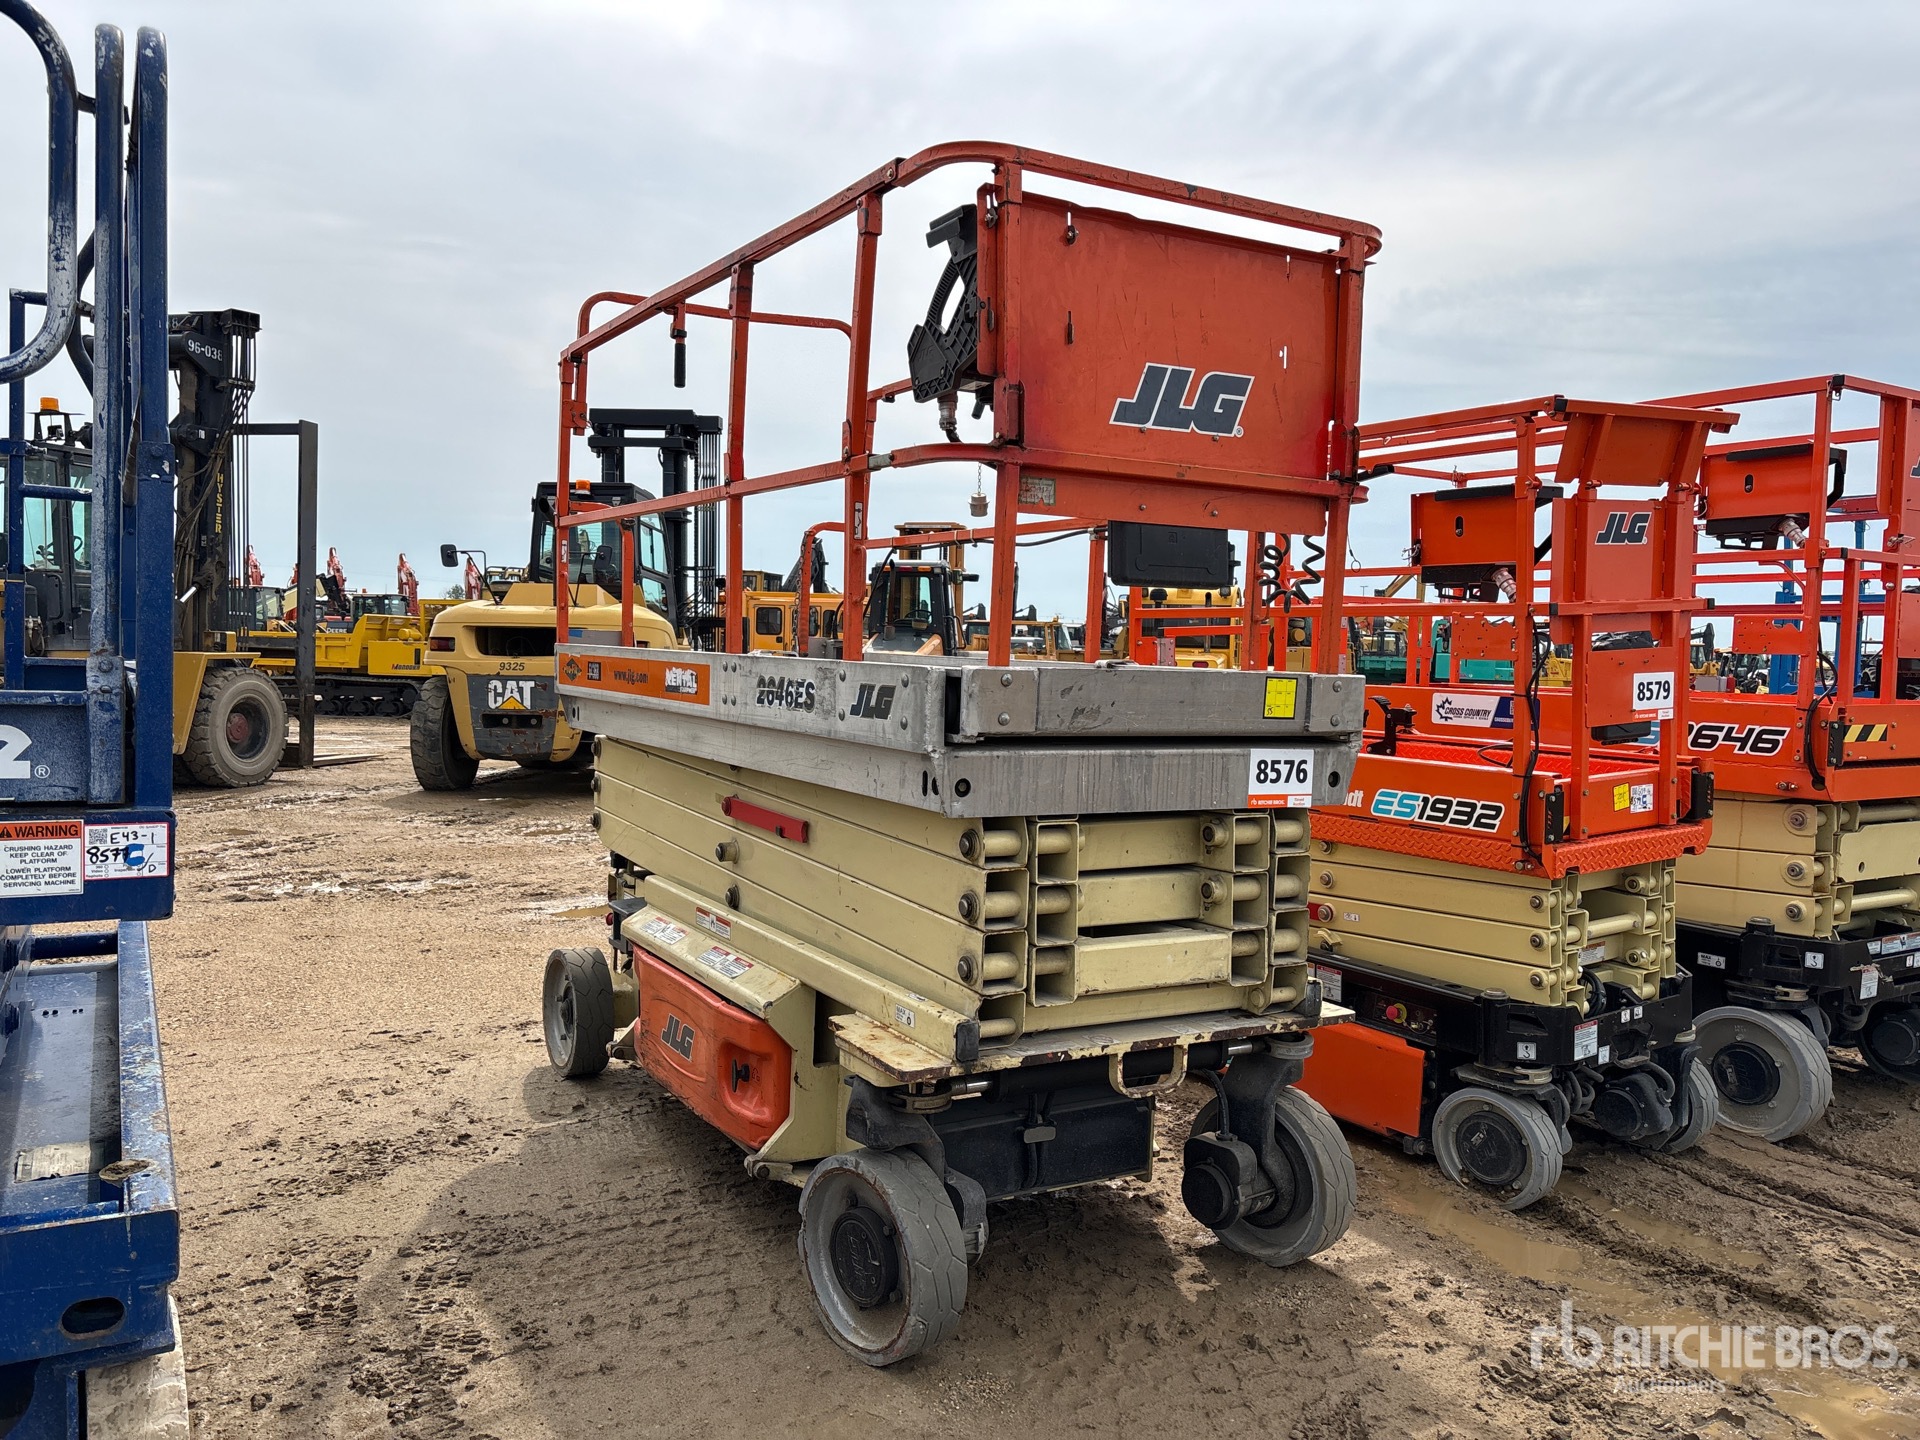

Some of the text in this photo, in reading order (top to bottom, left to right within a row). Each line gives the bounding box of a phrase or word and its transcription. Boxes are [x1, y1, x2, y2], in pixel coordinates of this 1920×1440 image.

[1109, 363, 1255, 437] JLG
[215, 473, 224, 533] HYSTER
[1595, 512, 1652, 545] JLG
[499, 662, 525, 671] 9325
[488, 680, 535, 710] CAT
[850, 683, 897, 720] JLG
[1637, 680, 1671, 701] 8579
[1444, 707, 1464, 716] CROSS
[1464, 708, 1492, 718] COUNTRY
[1688, 722, 1790, 756] 646
[1256, 760, 1308, 784] 8576
[1371, 788, 1505, 833] ES1932
[14, 824, 79, 838] WARNING
[0, 873, 46, 881] COMPLETELY
[3, 880, 42, 888] SERVICING
[661, 1013, 695, 1062] JLG
